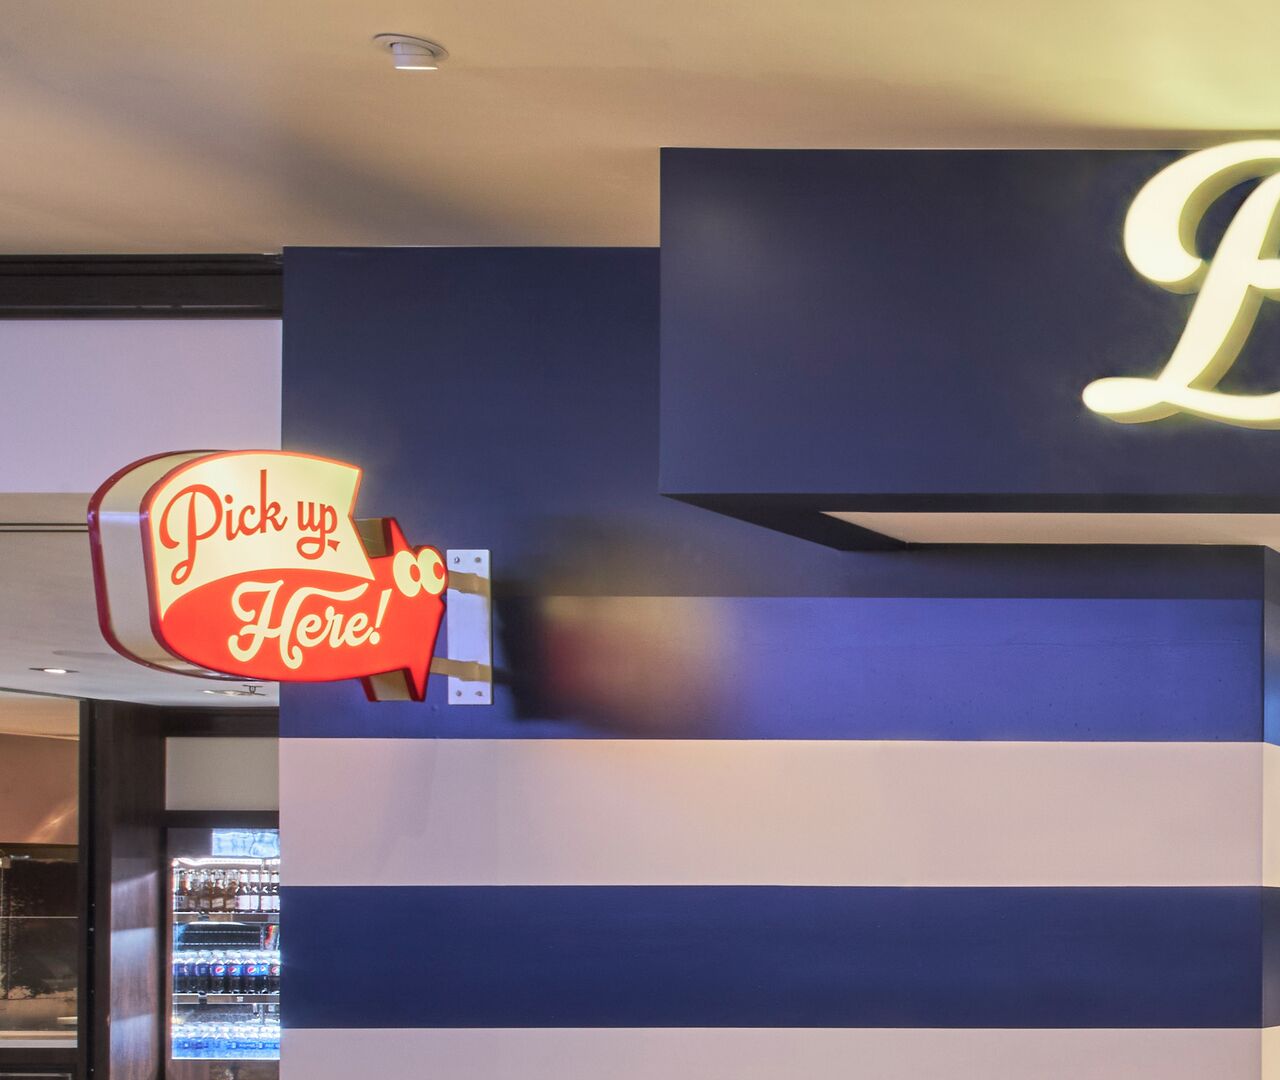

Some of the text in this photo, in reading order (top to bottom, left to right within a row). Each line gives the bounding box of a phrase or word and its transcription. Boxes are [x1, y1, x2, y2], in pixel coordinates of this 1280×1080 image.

[159, 469, 341, 585] Pick up
[227, 579, 393, 670] Here!
